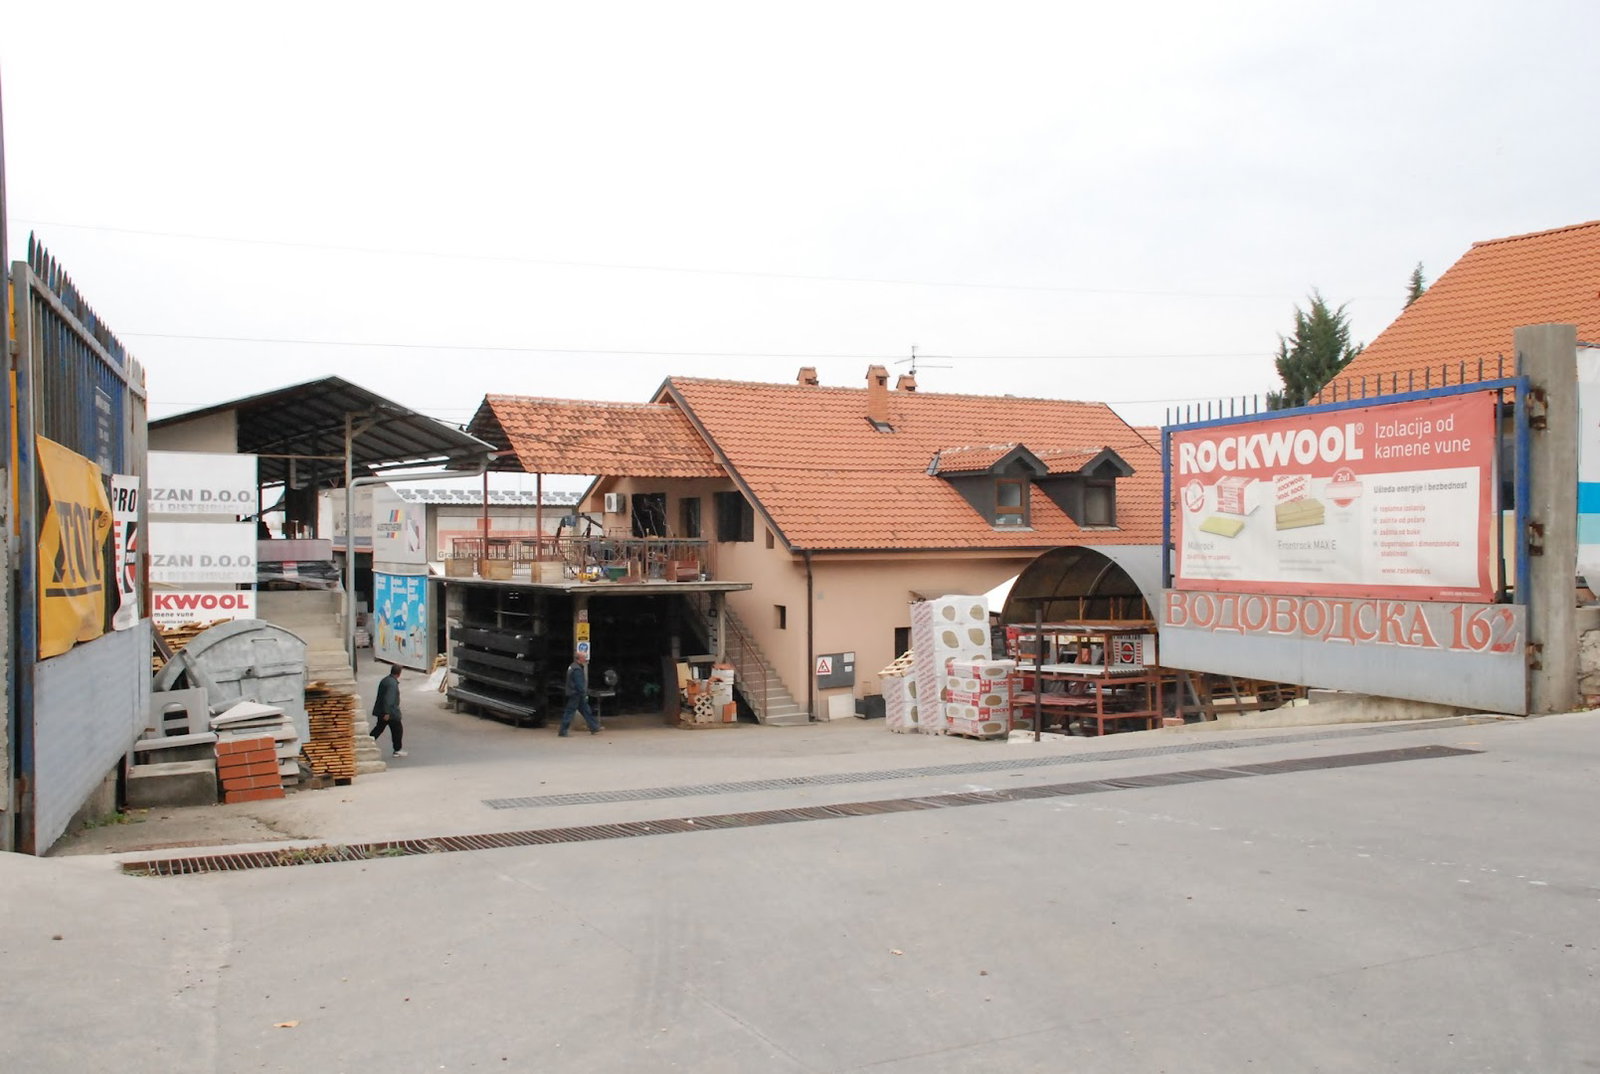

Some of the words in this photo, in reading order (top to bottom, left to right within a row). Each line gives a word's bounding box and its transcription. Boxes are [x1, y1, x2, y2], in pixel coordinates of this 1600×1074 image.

[1375, 418, 1431, 440] Izolacija
[1436, 414, 1455, 433] od
[1375, 439, 1431, 460] kamene
[1435, 437, 1472, 454] vune
[1428, 482, 1468, 491] bezbednost
[1165, 591, 1440, 649] ВОДОВОДСКА
[1449, 604, 1521, 654] 162
